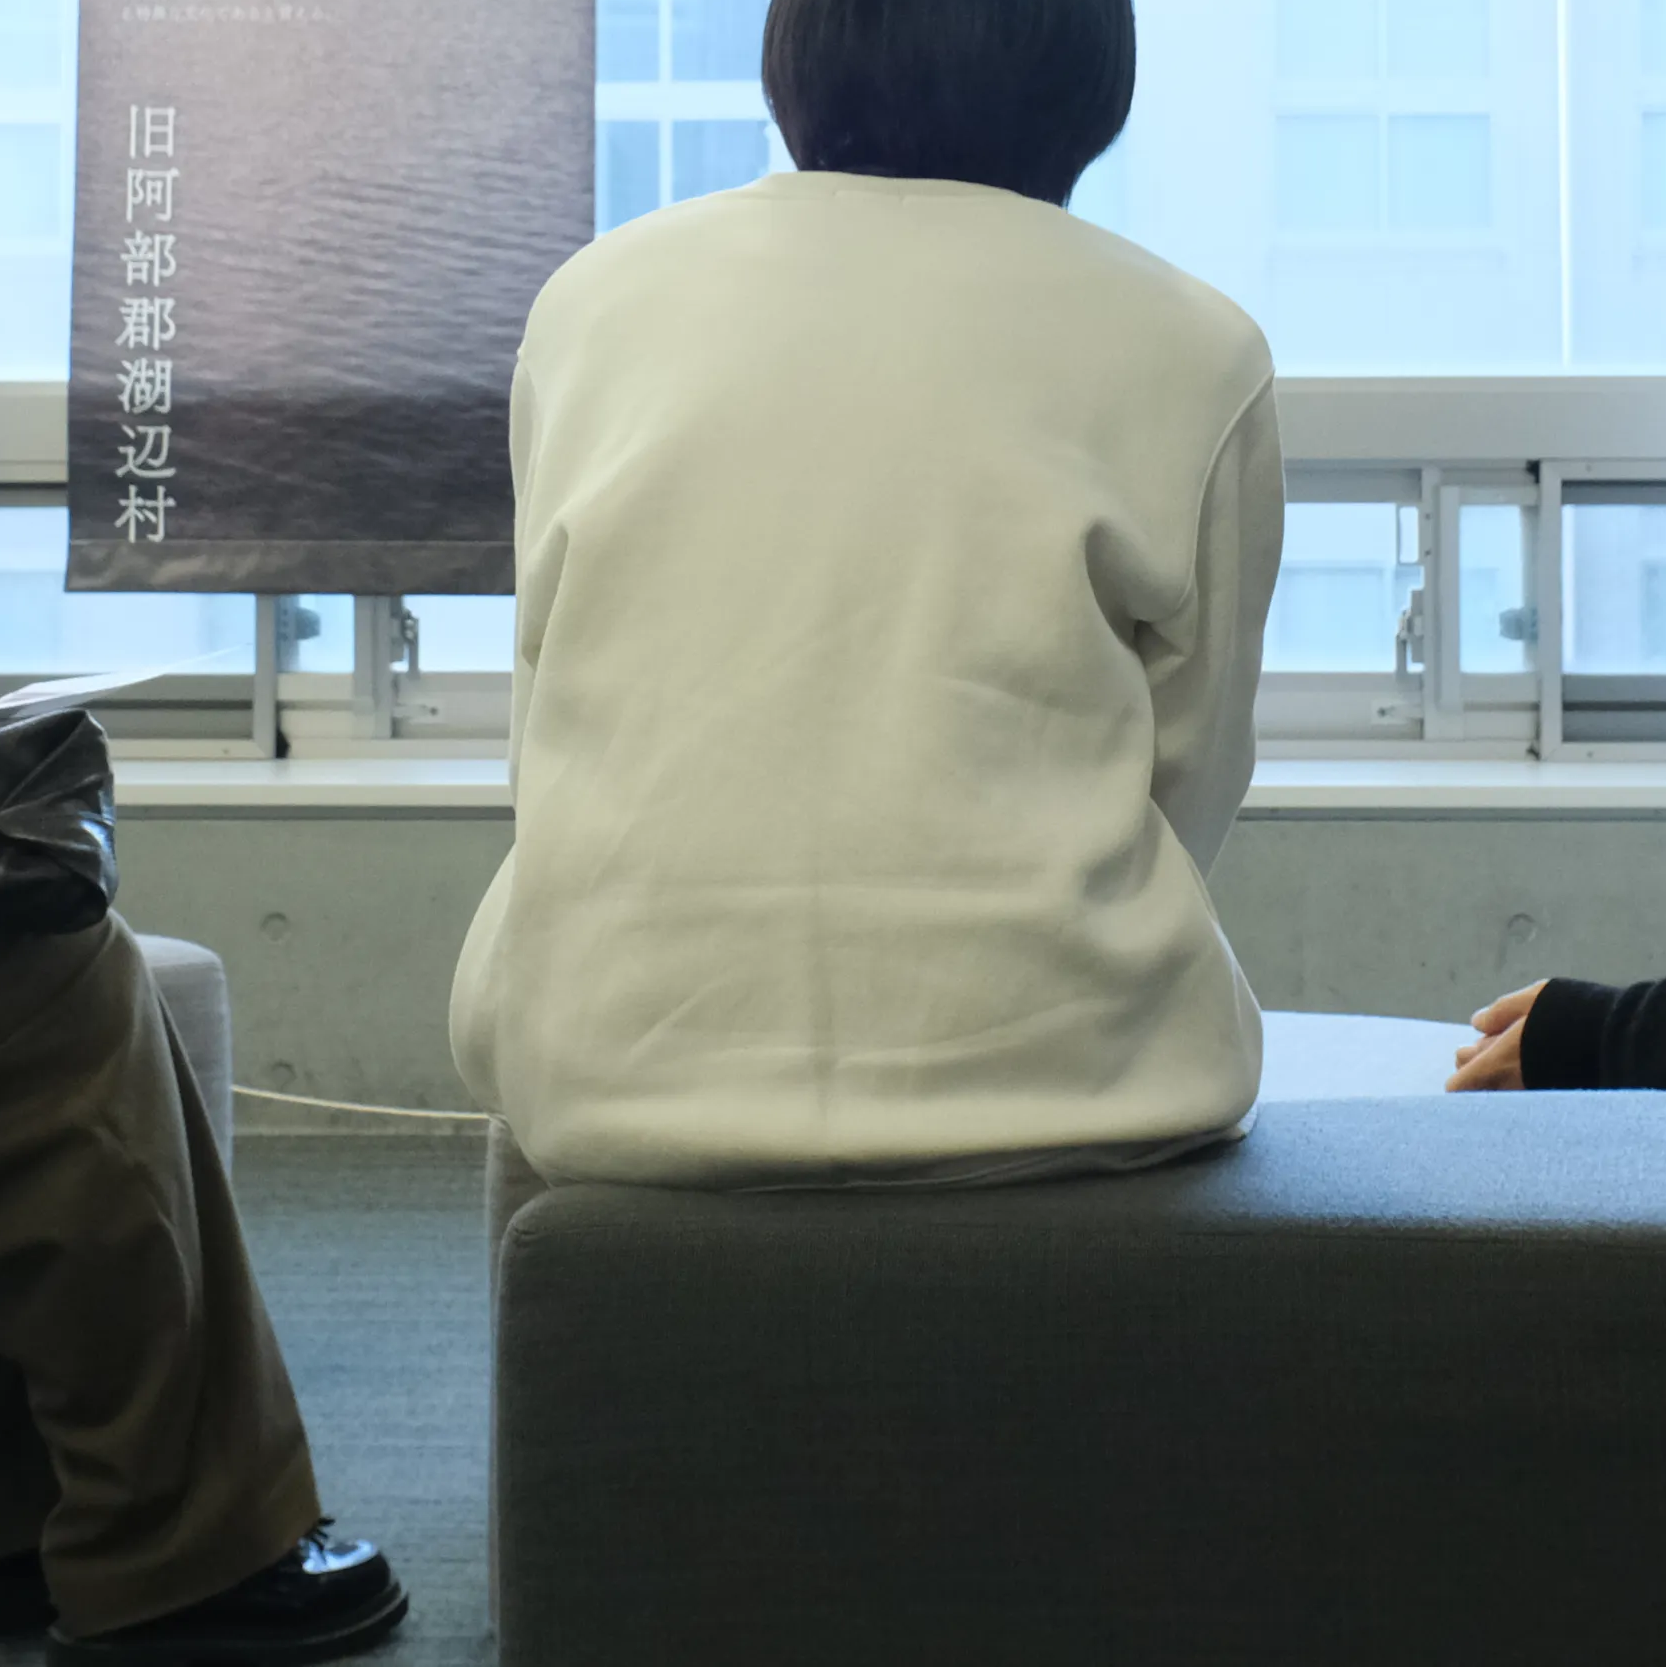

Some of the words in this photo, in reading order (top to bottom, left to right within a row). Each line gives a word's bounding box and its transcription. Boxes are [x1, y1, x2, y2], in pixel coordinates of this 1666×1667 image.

[114, 103, 180, 545] 旧阿部郡湖辺村
